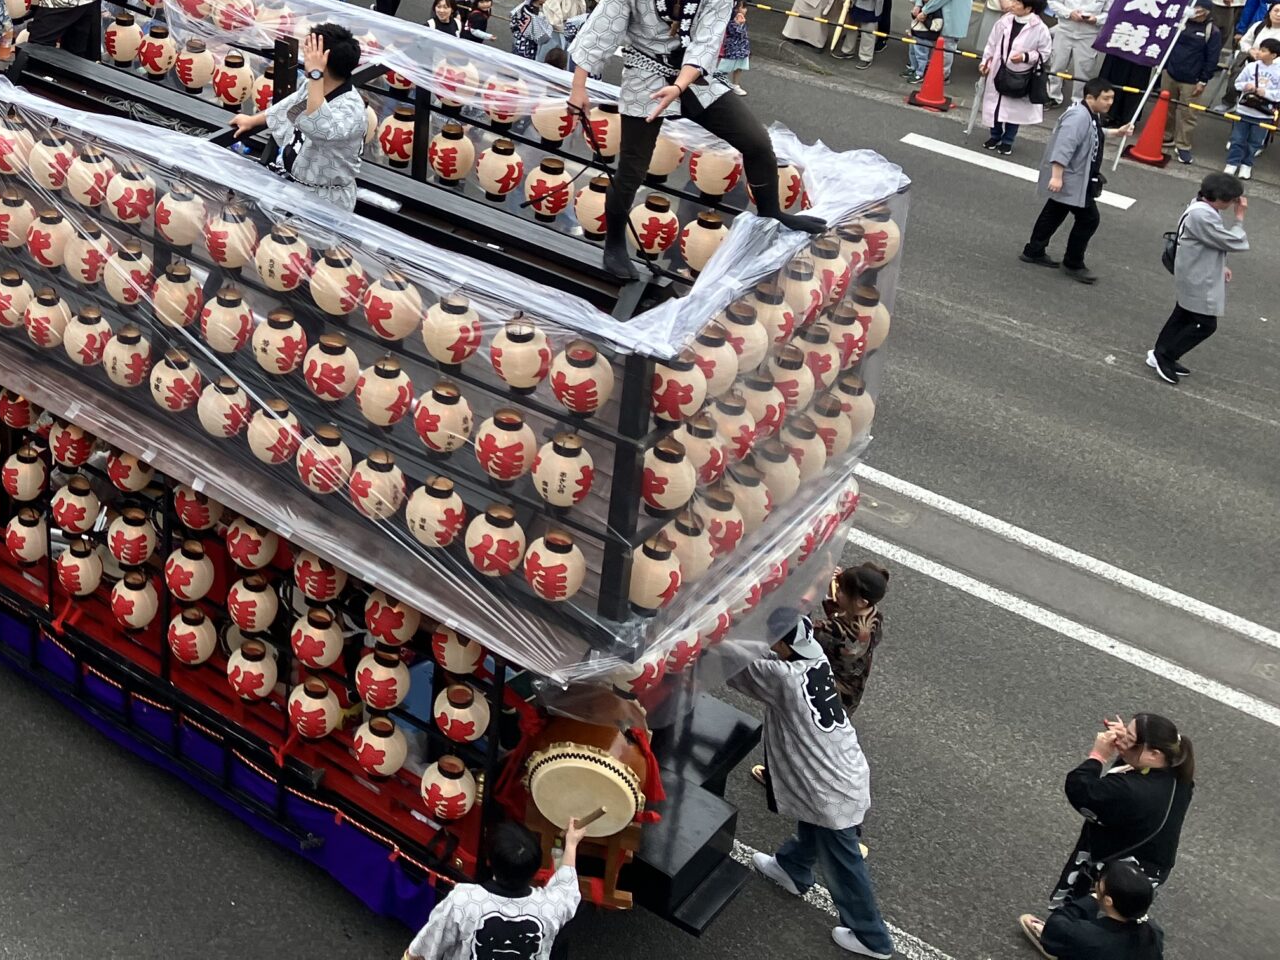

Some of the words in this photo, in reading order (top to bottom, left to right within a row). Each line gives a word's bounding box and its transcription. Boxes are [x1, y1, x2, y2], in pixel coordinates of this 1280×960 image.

[136, 40, 164, 72] 伏
[213, 69, 238, 103] 伏
[379, 125, 415, 159] 伏
[428, 142, 459, 177] 拝
[114, 188, 156, 221] 伏
[529, 179, 569, 213] 拝
[27, 228, 53, 265] 伏
[640, 216, 677, 250] 拝
[304, 360, 345, 398] 伏
[552, 372, 597, 411] 拝
[54, 431, 91, 465] 拝
[477, 434, 525, 479] 拝
[52, 498, 86, 532] 伏
[111, 530, 148, 564] 拝
[224, 528, 261, 568] 伏
[469, 534, 520, 574] 伏
[164, 559, 193, 599] 伏
[296, 560, 336, 600] 拝
[524, 552, 567, 599] 拝
[365, 601, 404, 644] 伏
[167, 624, 199, 663] 拝
[290, 629, 326, 669] 伏
[227, 666, 265, 701] 伏
[357, 667, 397, 709] 拝
[289, 700, 326, 735] 拝
[423, 783, 468, 821] 拝
